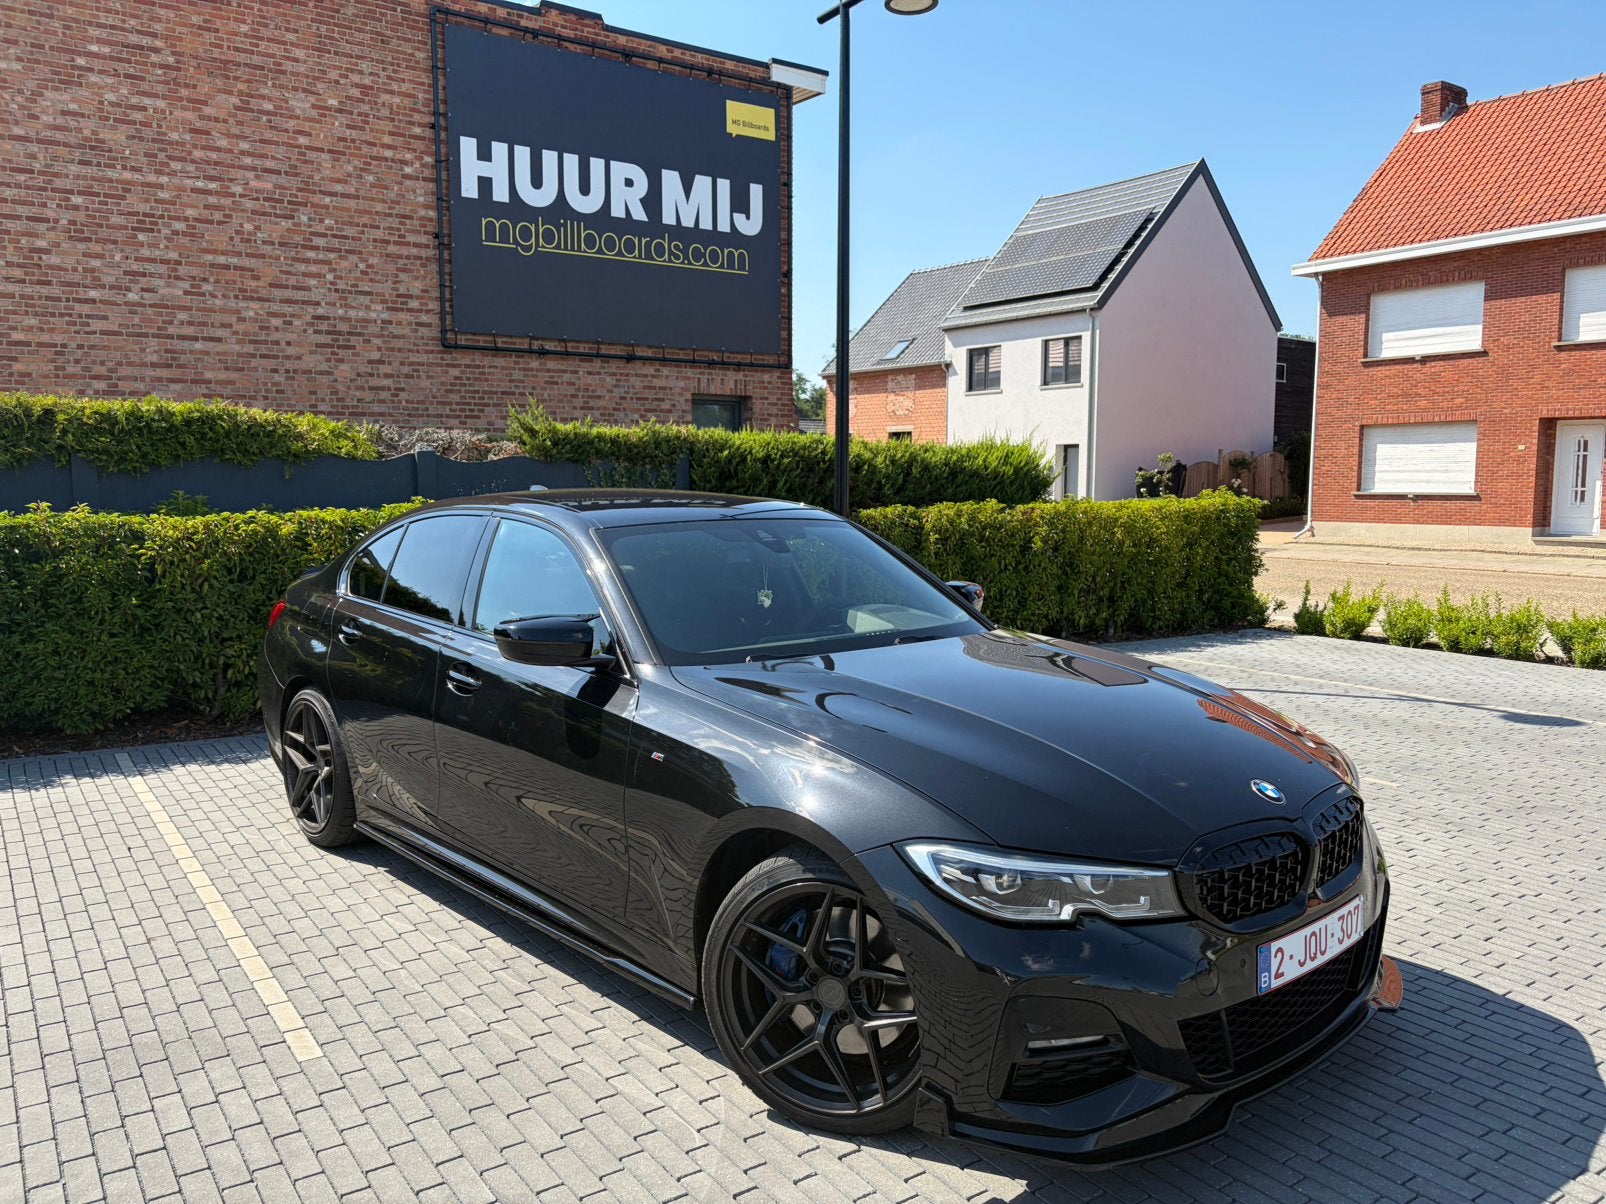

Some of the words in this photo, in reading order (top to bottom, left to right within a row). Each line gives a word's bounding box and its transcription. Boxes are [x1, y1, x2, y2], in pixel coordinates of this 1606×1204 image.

[731, 118, 741, 127] MG
[742, 120, 770, 132] Billboards
[460, 136, 648, 222] HUUR
[661, 168, 763, 236] MIJ
[481, 216, 749, 272] mgbillboards.com
[1273, 904, 1360, 981] 2-JQU-307
[1261, 972, 1269, 987] B
